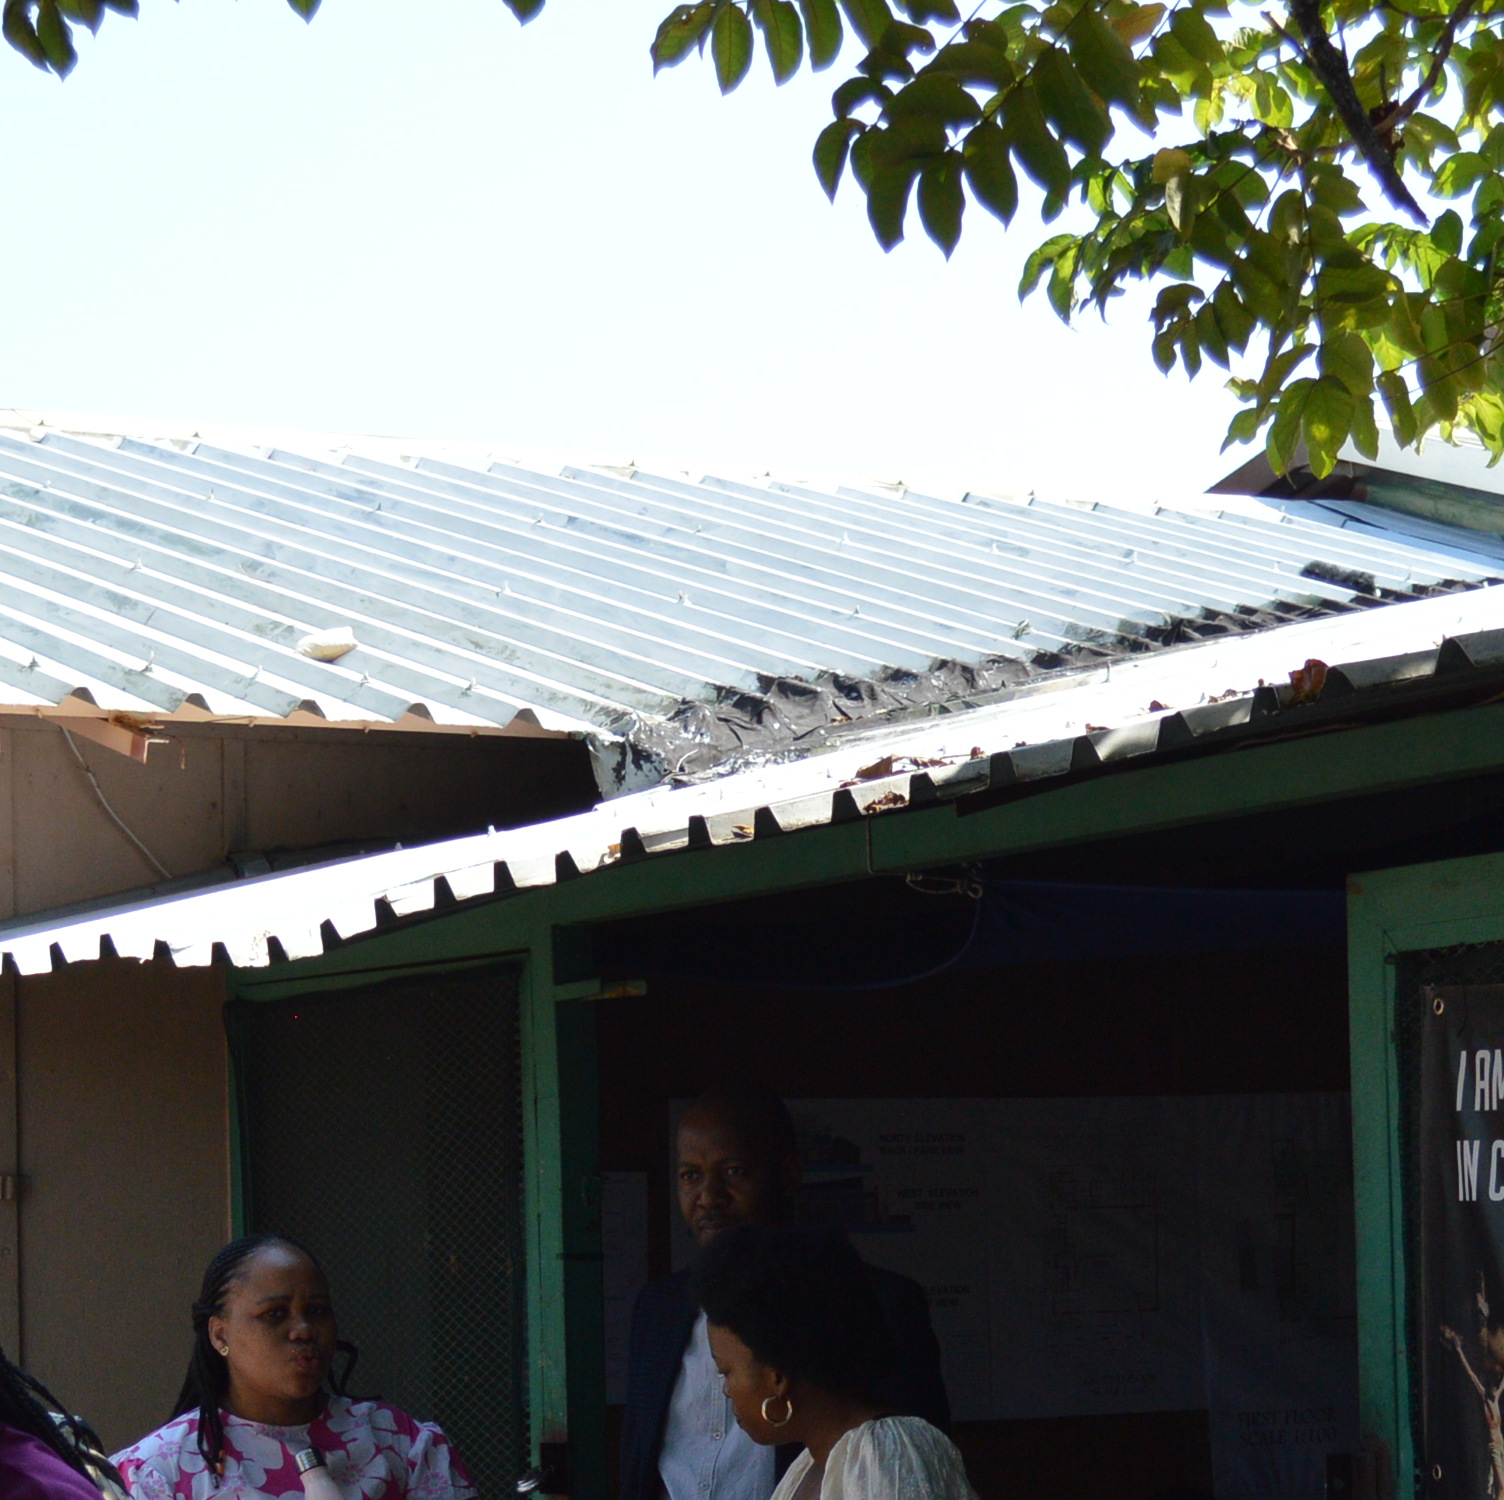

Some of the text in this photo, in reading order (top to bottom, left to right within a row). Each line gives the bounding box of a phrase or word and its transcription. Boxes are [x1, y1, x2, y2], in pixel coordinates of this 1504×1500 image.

[1456, 1050, 1467, 1111] I
[1456, 1139, 1481, 1202] IN
[1238, 1406, 1338, 1428] FIRST FLOOR
[1240, 1428, 1287, 1447] SCALE
